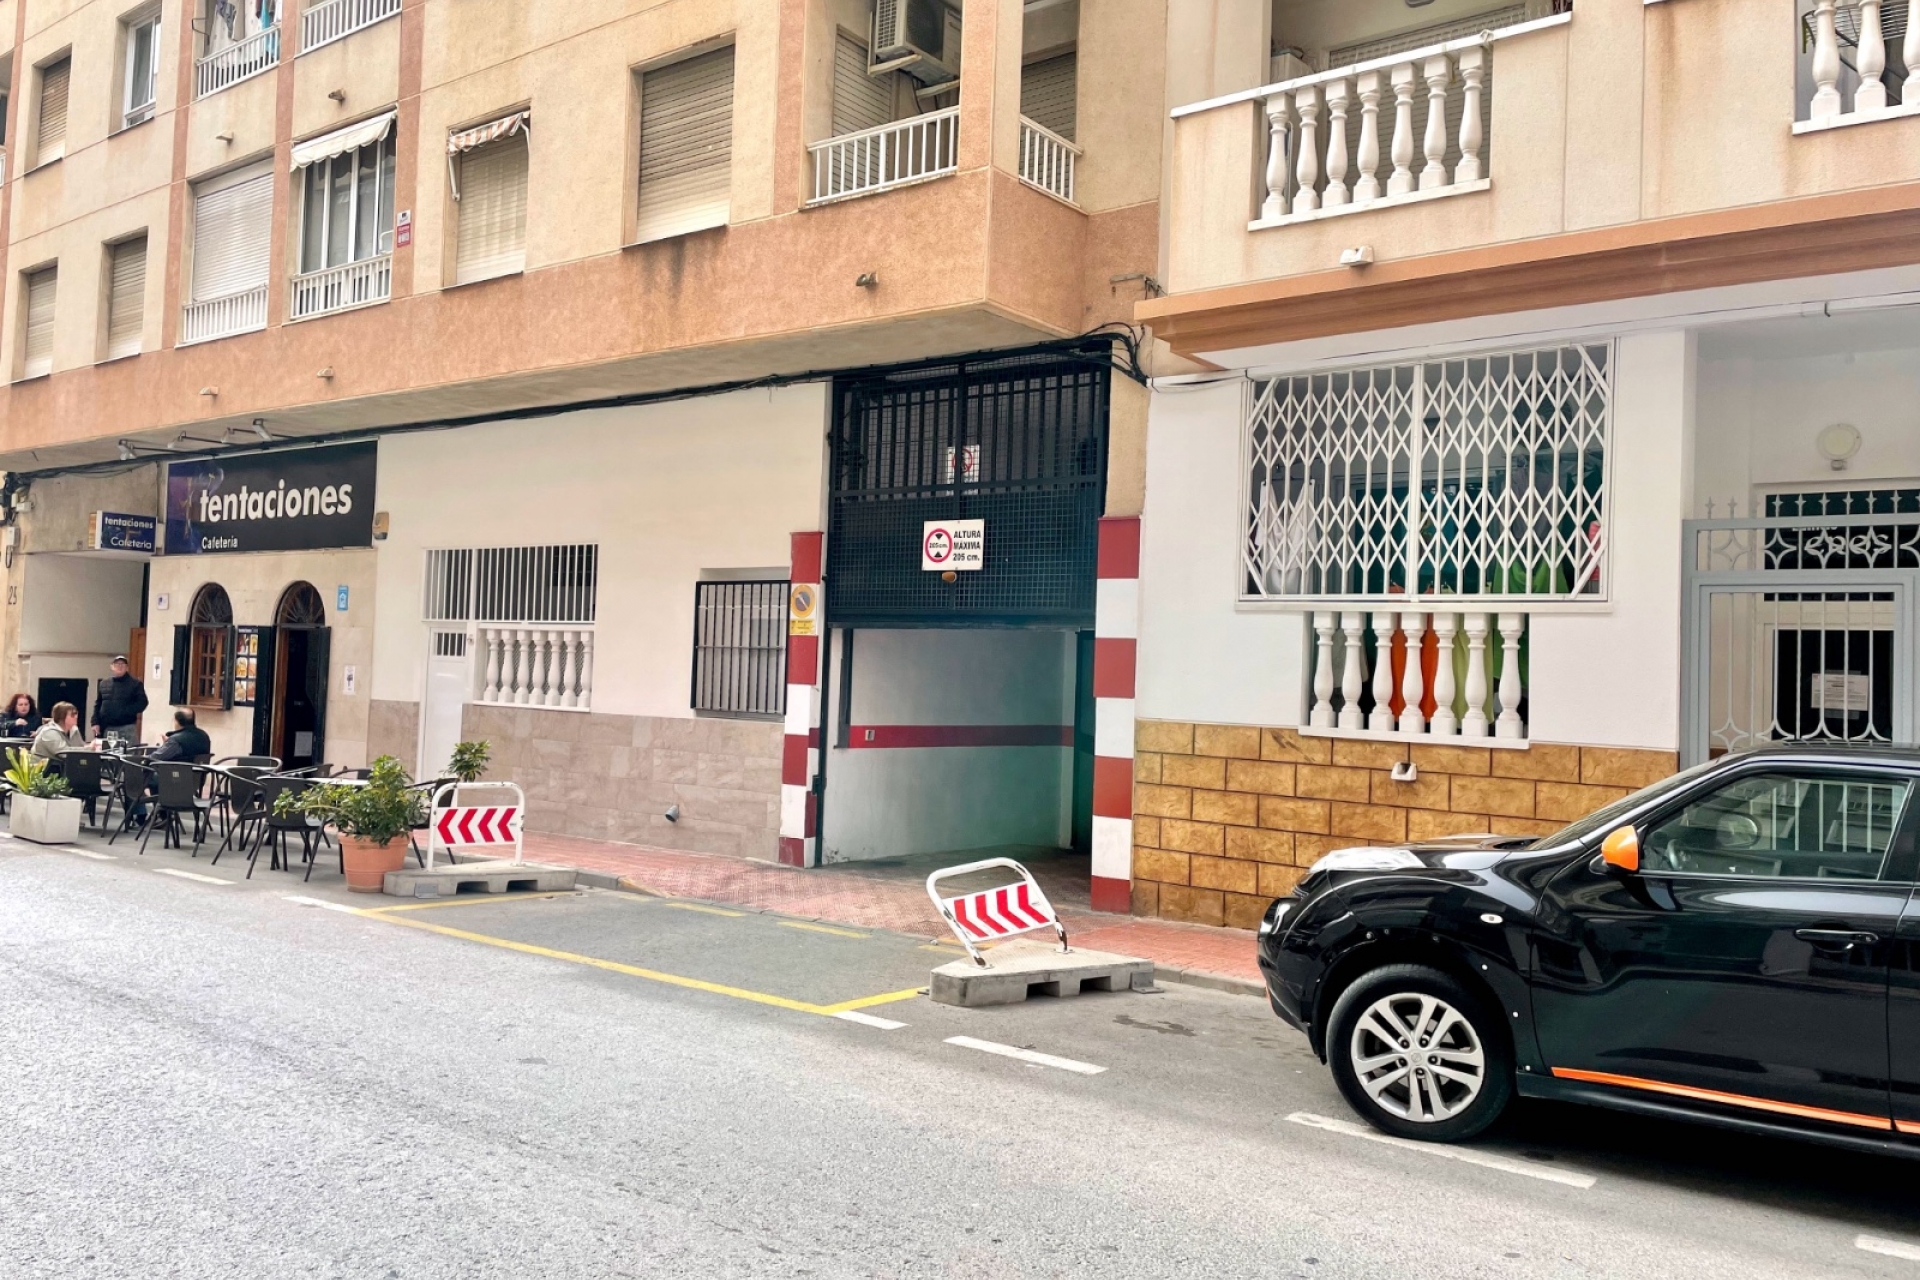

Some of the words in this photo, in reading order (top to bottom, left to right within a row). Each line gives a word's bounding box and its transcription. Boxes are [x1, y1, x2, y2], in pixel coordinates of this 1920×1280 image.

[200, 479, 353, 522] tentaciones
[105, 517, 154, 529] tentaciones
[953, 530, 981, 539] ALTURA
[952, 552, 966, 562] 205
[8, 585, 18, 605] 25
